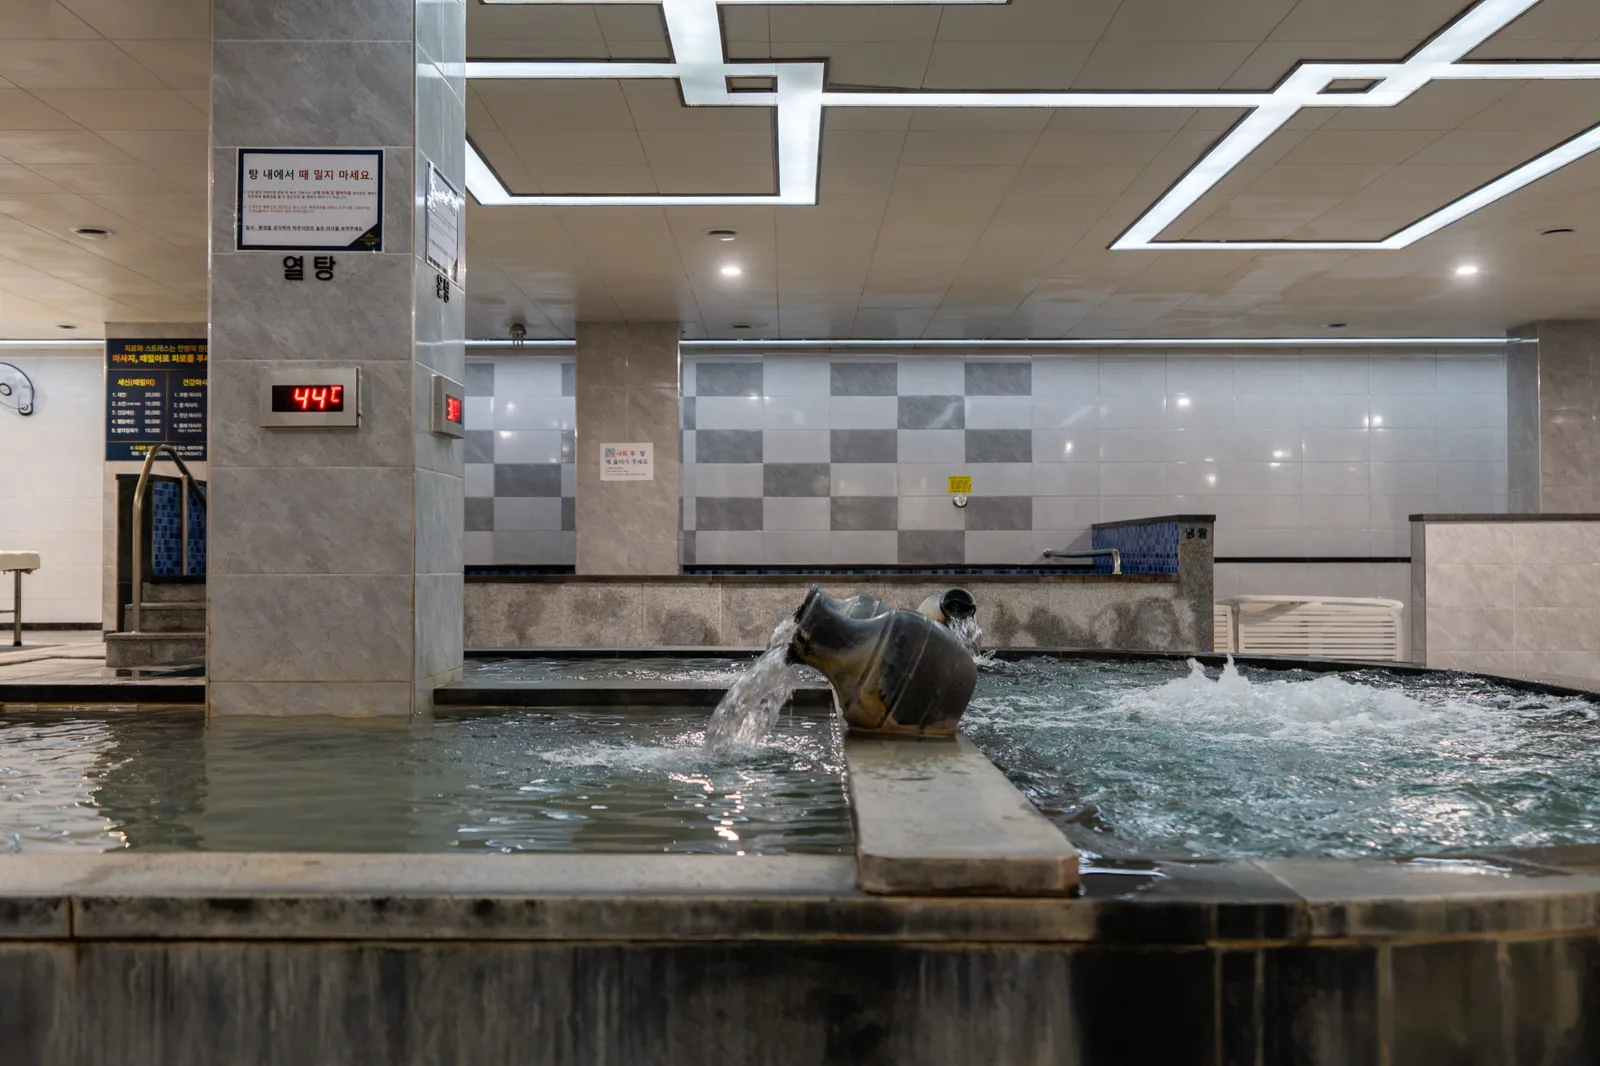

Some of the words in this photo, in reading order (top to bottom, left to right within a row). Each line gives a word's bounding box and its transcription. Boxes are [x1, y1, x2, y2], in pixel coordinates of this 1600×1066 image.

[248, 169, 259, 180] 탕
[263, 169, 294, 180] 내에서
[298, 170, 309, 180] 때
[314, 170, 334, 180] 밀지
[338, 170, 373, 181] 마세요.
[124, 344, 143, 352] 피로와
[145, 344, 176, 352] 스트레스는
[178, 344, 196, 352] 만병의
[112, 354, 138, 364] 마사지,
[139, 354, 170, 363] 때밀이로
[172, 354, 194, 363] 피로를
[117, 378, 156, 387] 세신(때밀이)
